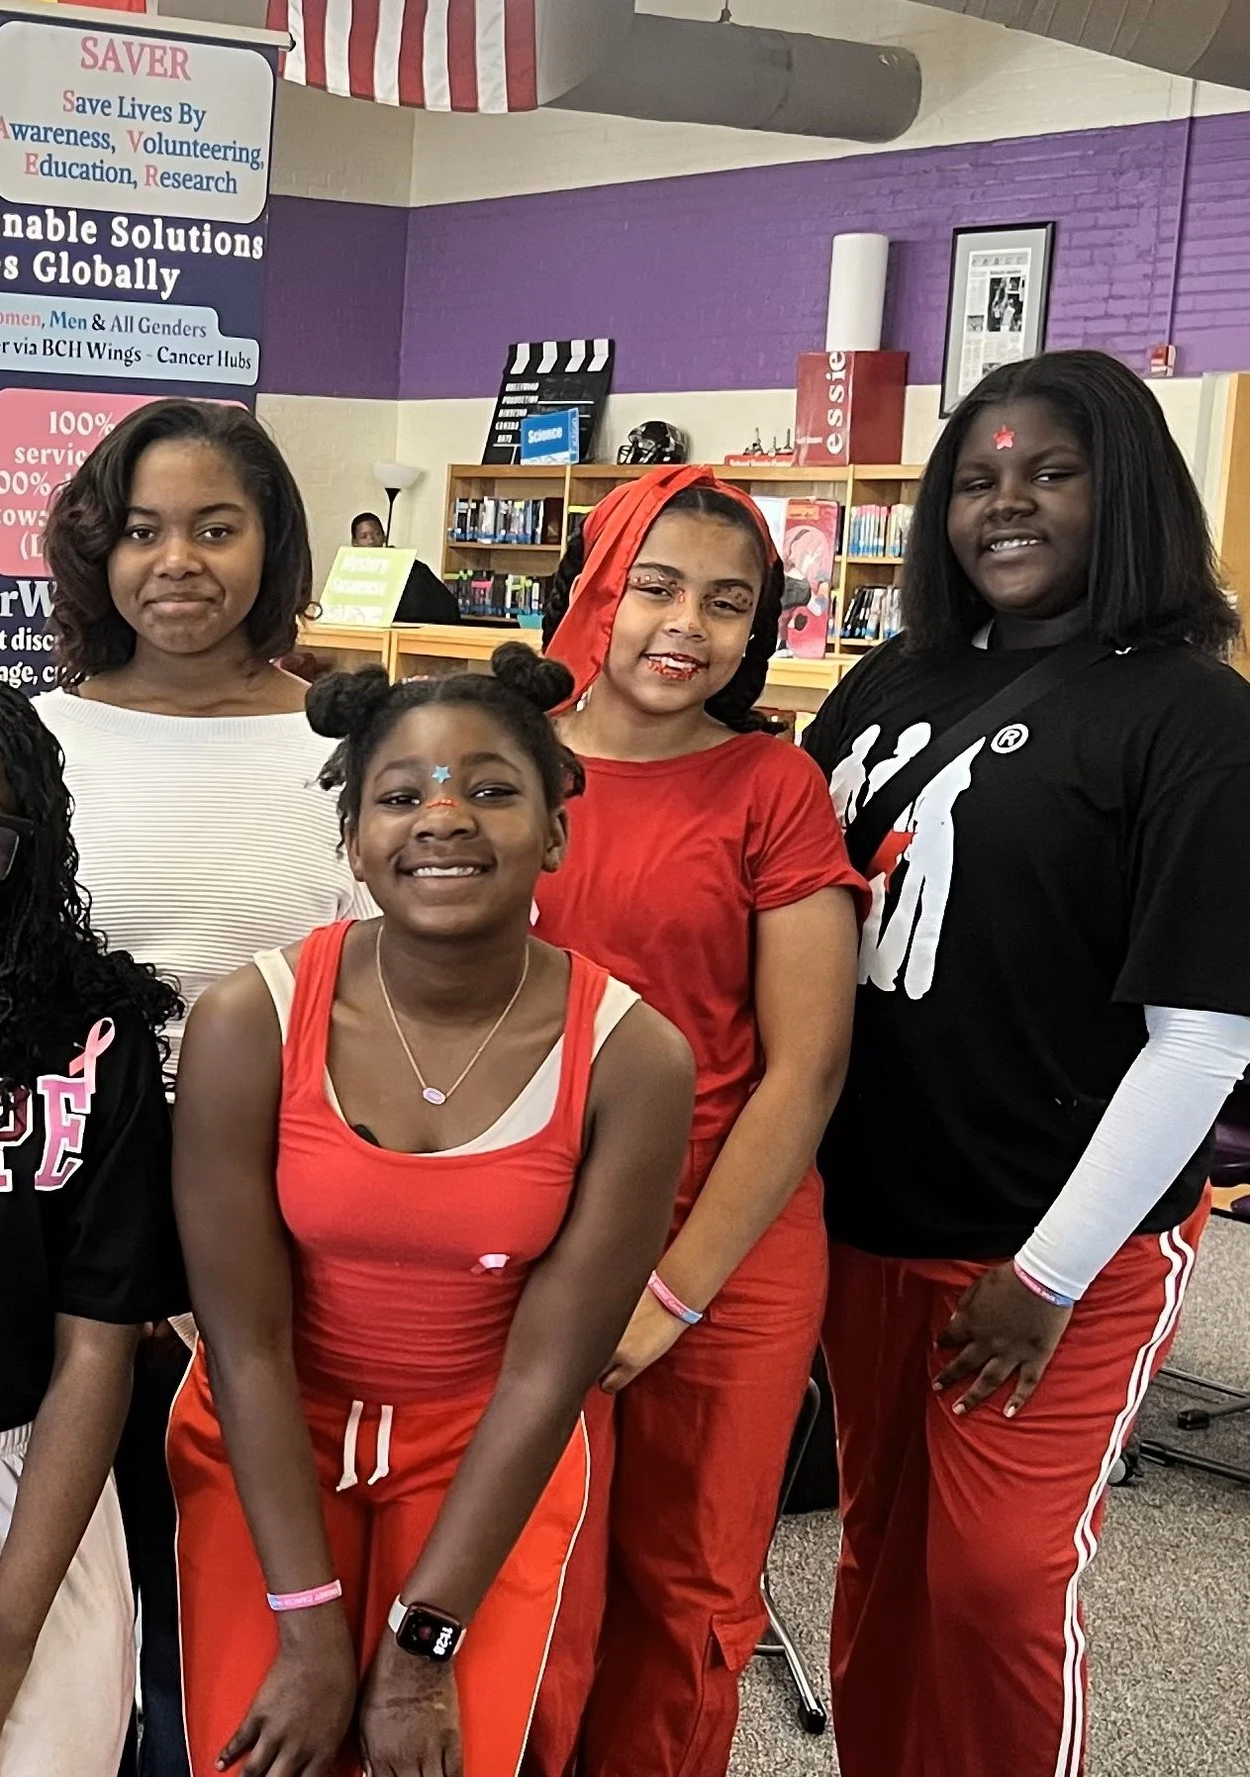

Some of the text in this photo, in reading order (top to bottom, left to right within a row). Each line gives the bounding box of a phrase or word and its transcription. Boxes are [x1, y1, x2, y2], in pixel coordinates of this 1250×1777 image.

[80, 36, 192, 81] SAVER
[62, 90, 207, 132] Save Lives By
[126, 129, 264, 171] Volunteering,
[24, 152, 238, 194] Education, Research
[110, 215, 264, 260] Solutions
[33, 250, 181, 301] Globally
[49, 310, 87, 331] Men
[92, 314, 106, 332] &
[110, 314, 134, 334] All
[138, 316, 207, 339] Genders
[13, 337, 37, 356] via
[42, 338, 81, 359] BCH
[86, 342, 142, 368] Wings
[156, 346, 214, 367] Cancer
[217, 349, 252, 370] Hubs
[49, 411, 115, 437] 100%
[825, 351, 847, 455] essie
[14, 443, 88, 467] servic
[528, 426, 563, 444] Science
[10, 626, 58, 652] disc
